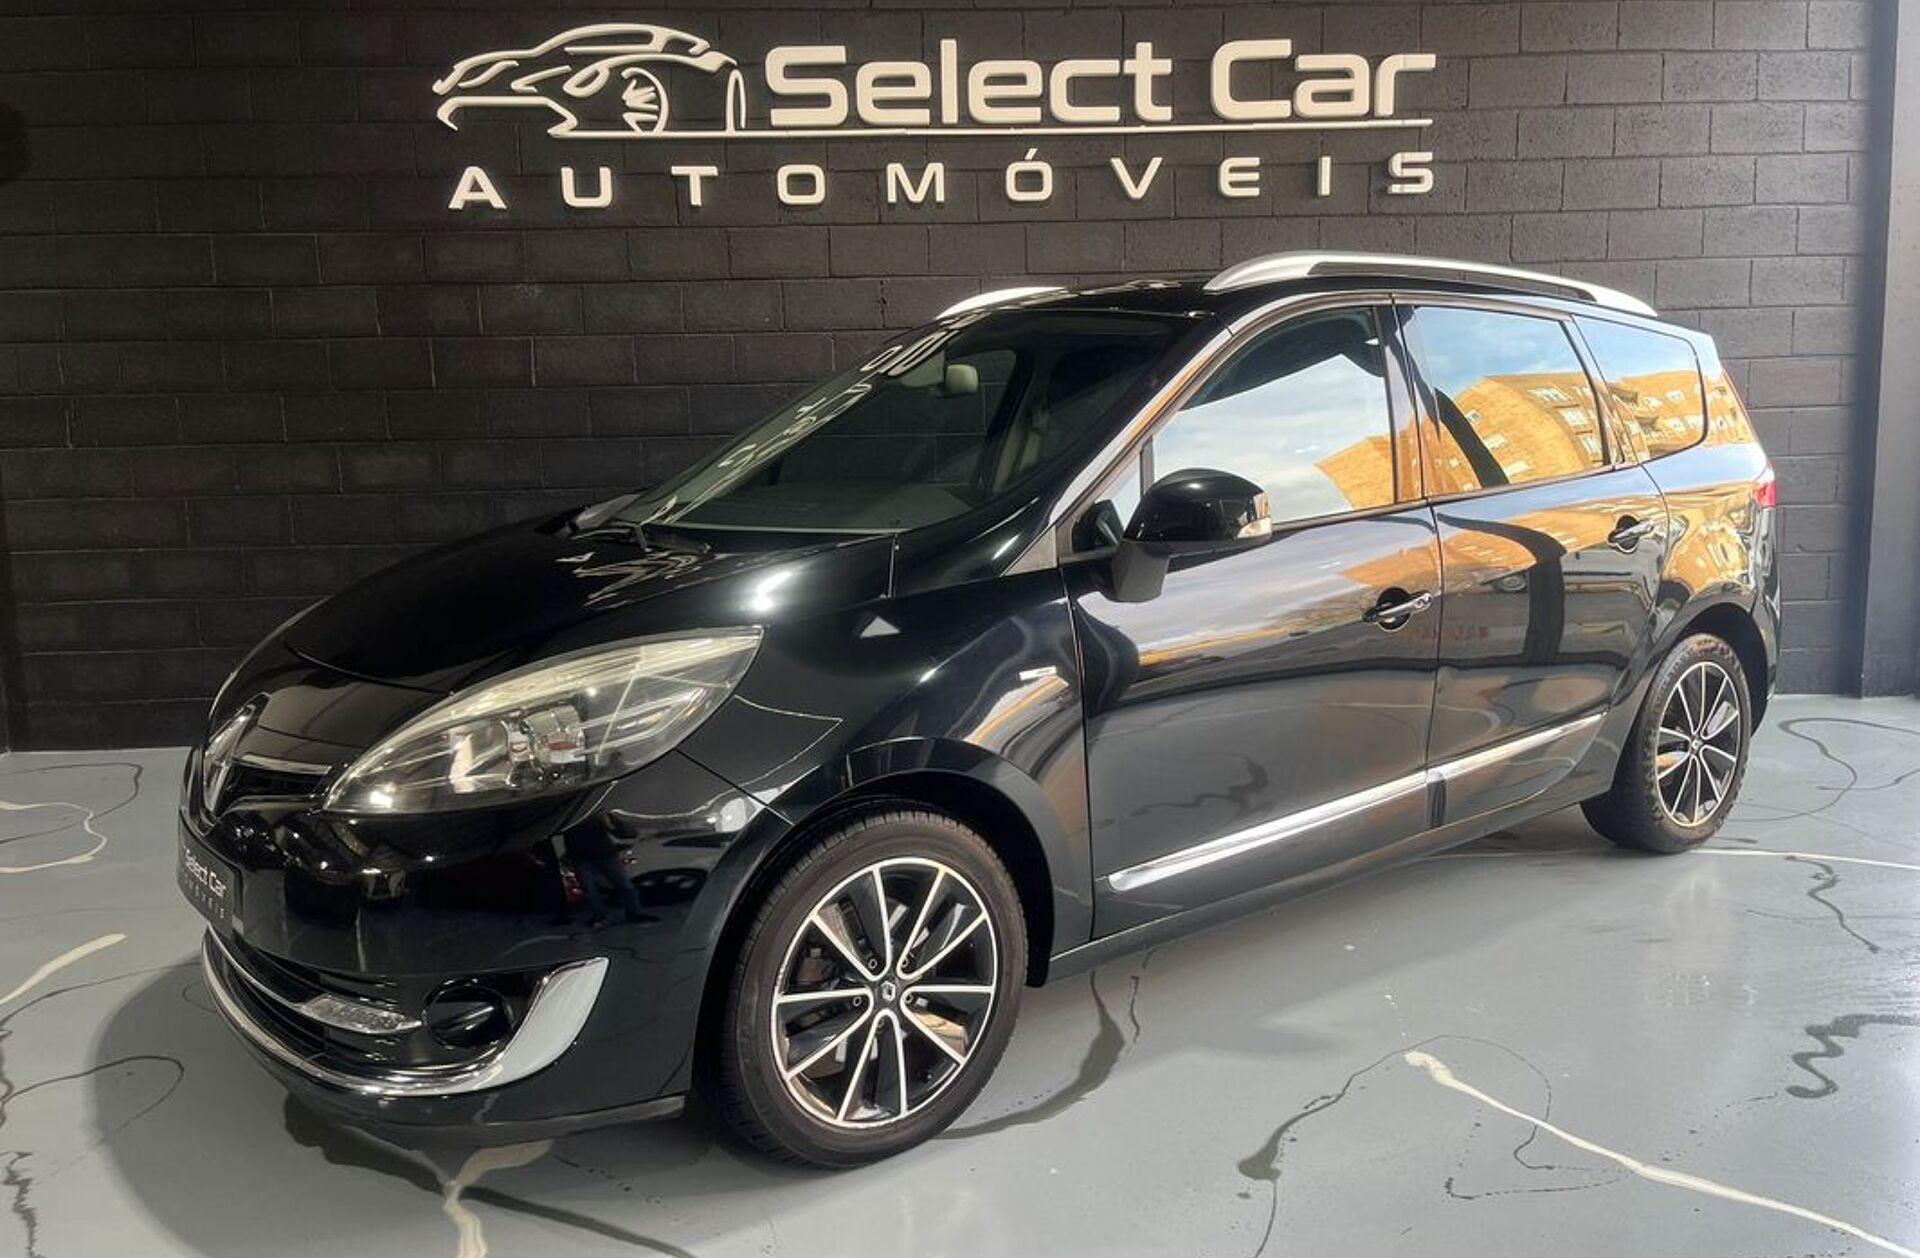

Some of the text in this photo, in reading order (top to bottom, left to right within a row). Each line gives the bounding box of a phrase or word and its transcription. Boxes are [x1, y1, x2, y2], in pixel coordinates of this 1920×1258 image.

[764, 38, 1437, 126] Select Car
[447, 147, 1436, 210] AUTOMÓVEIS
[208, 870, 227, 898] Car
